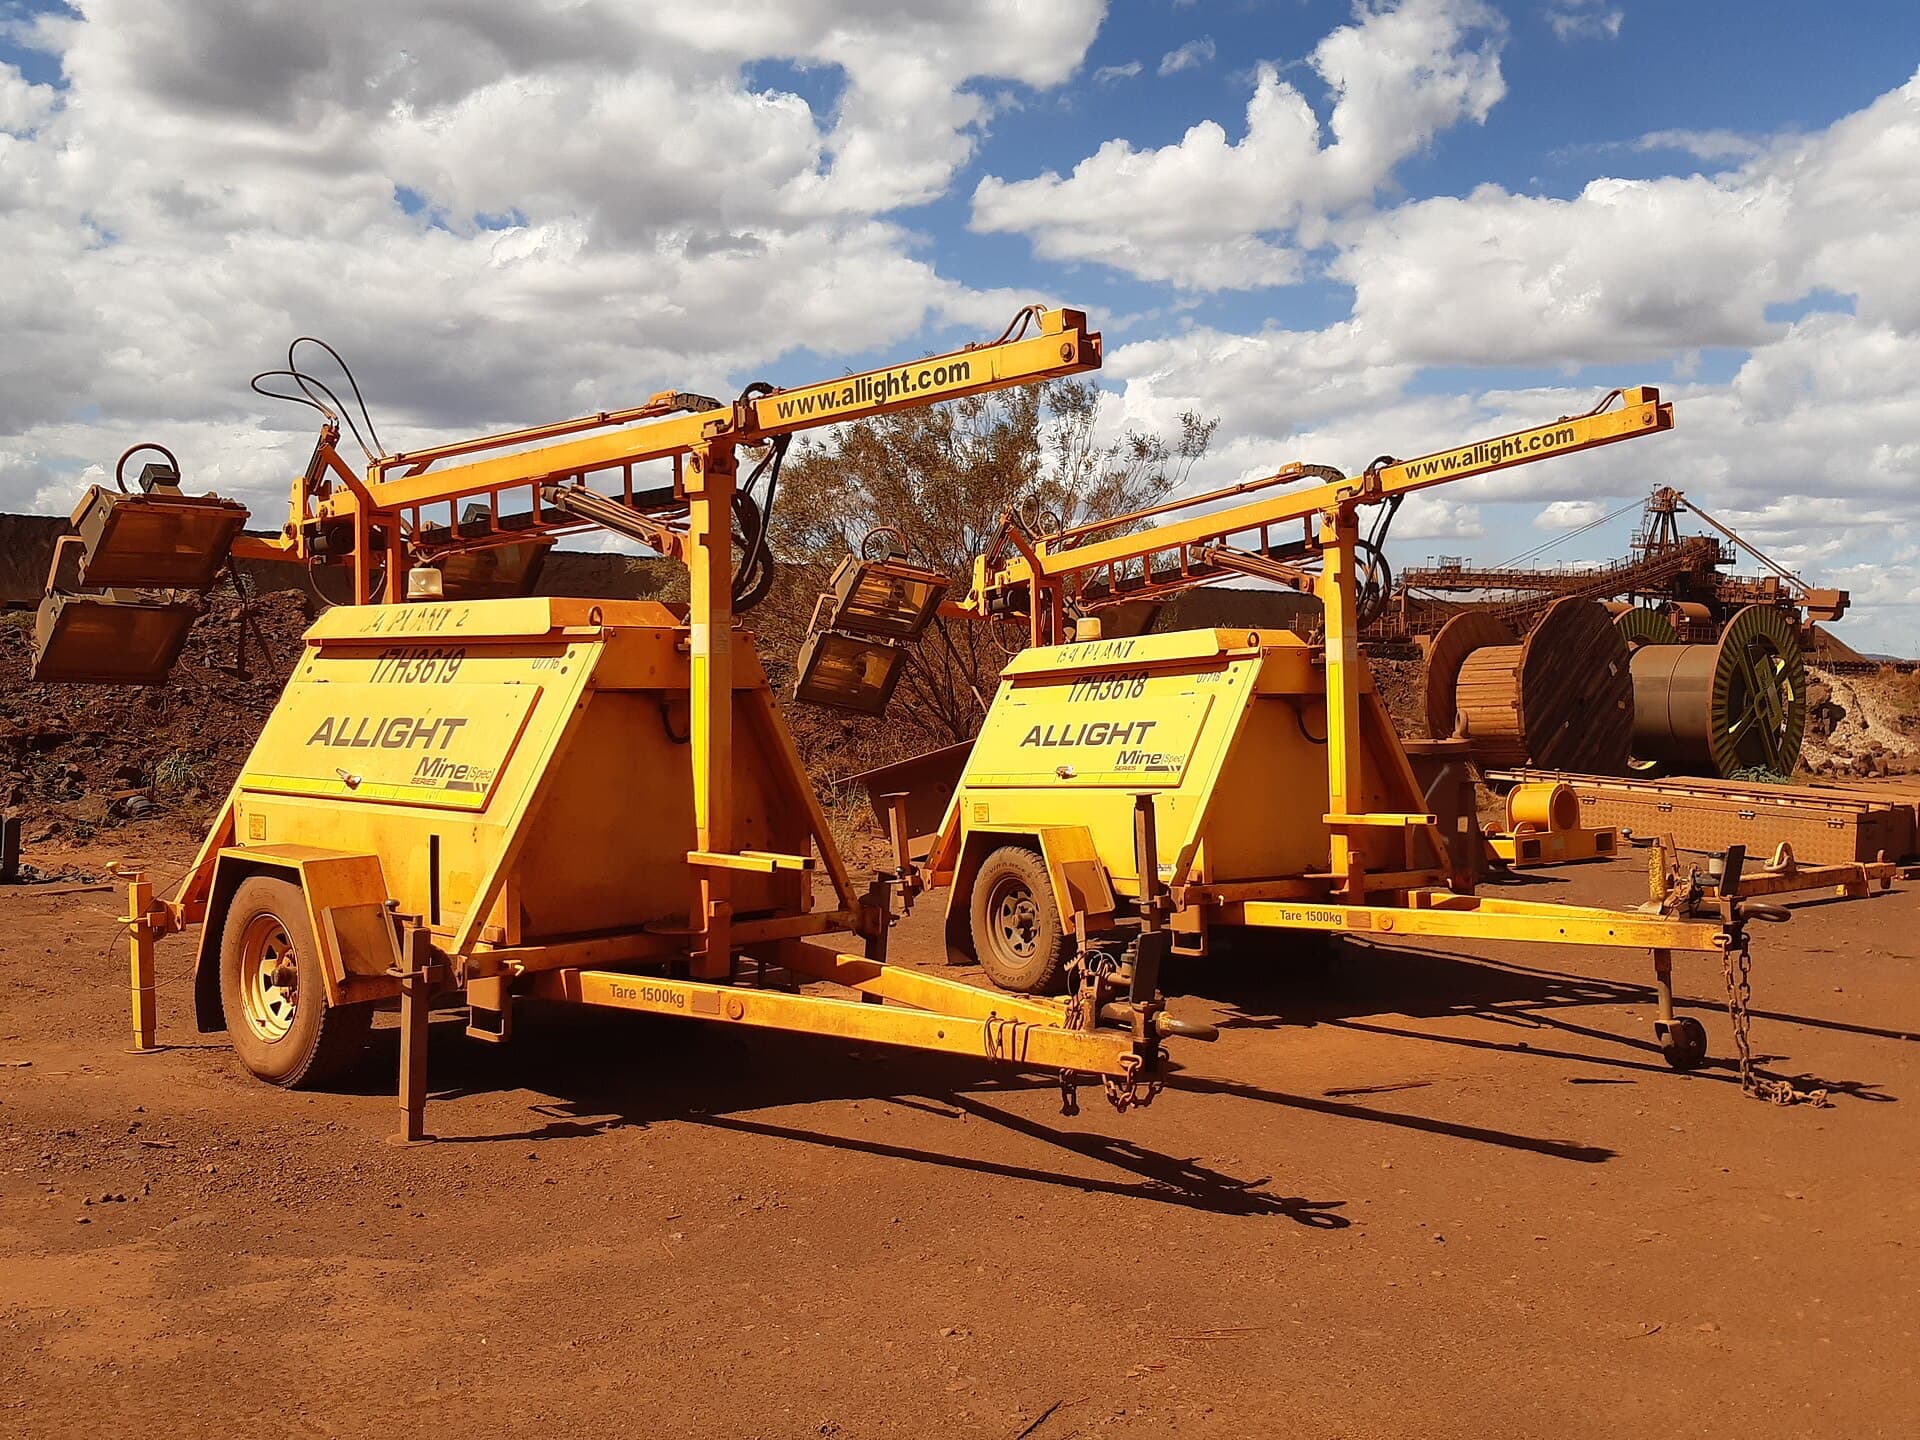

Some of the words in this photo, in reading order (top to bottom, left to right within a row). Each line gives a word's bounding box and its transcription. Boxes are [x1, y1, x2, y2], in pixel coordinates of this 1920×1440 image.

[777, 360, 970, 419] www.allight.com
[1405, 426, 1575, 479] www.allight.com
[455, 608, 470, 628] 2
[369, 647, 466, 684] 17H3619
[1067, 671, 1150, 703] 17H3618
[306, 717, 468, 750] ALLIGHT
[1020, 721, 1157, 748] ALLIGHT
[410, 777, 438, 786] SERIES
[1279, 909, 1302, 921] Tare
[1305, 911, 1342, 925] 1500kg
[609, 983, 637, 1000] Tare
[640, 986, 685, 1008] 1500kg
